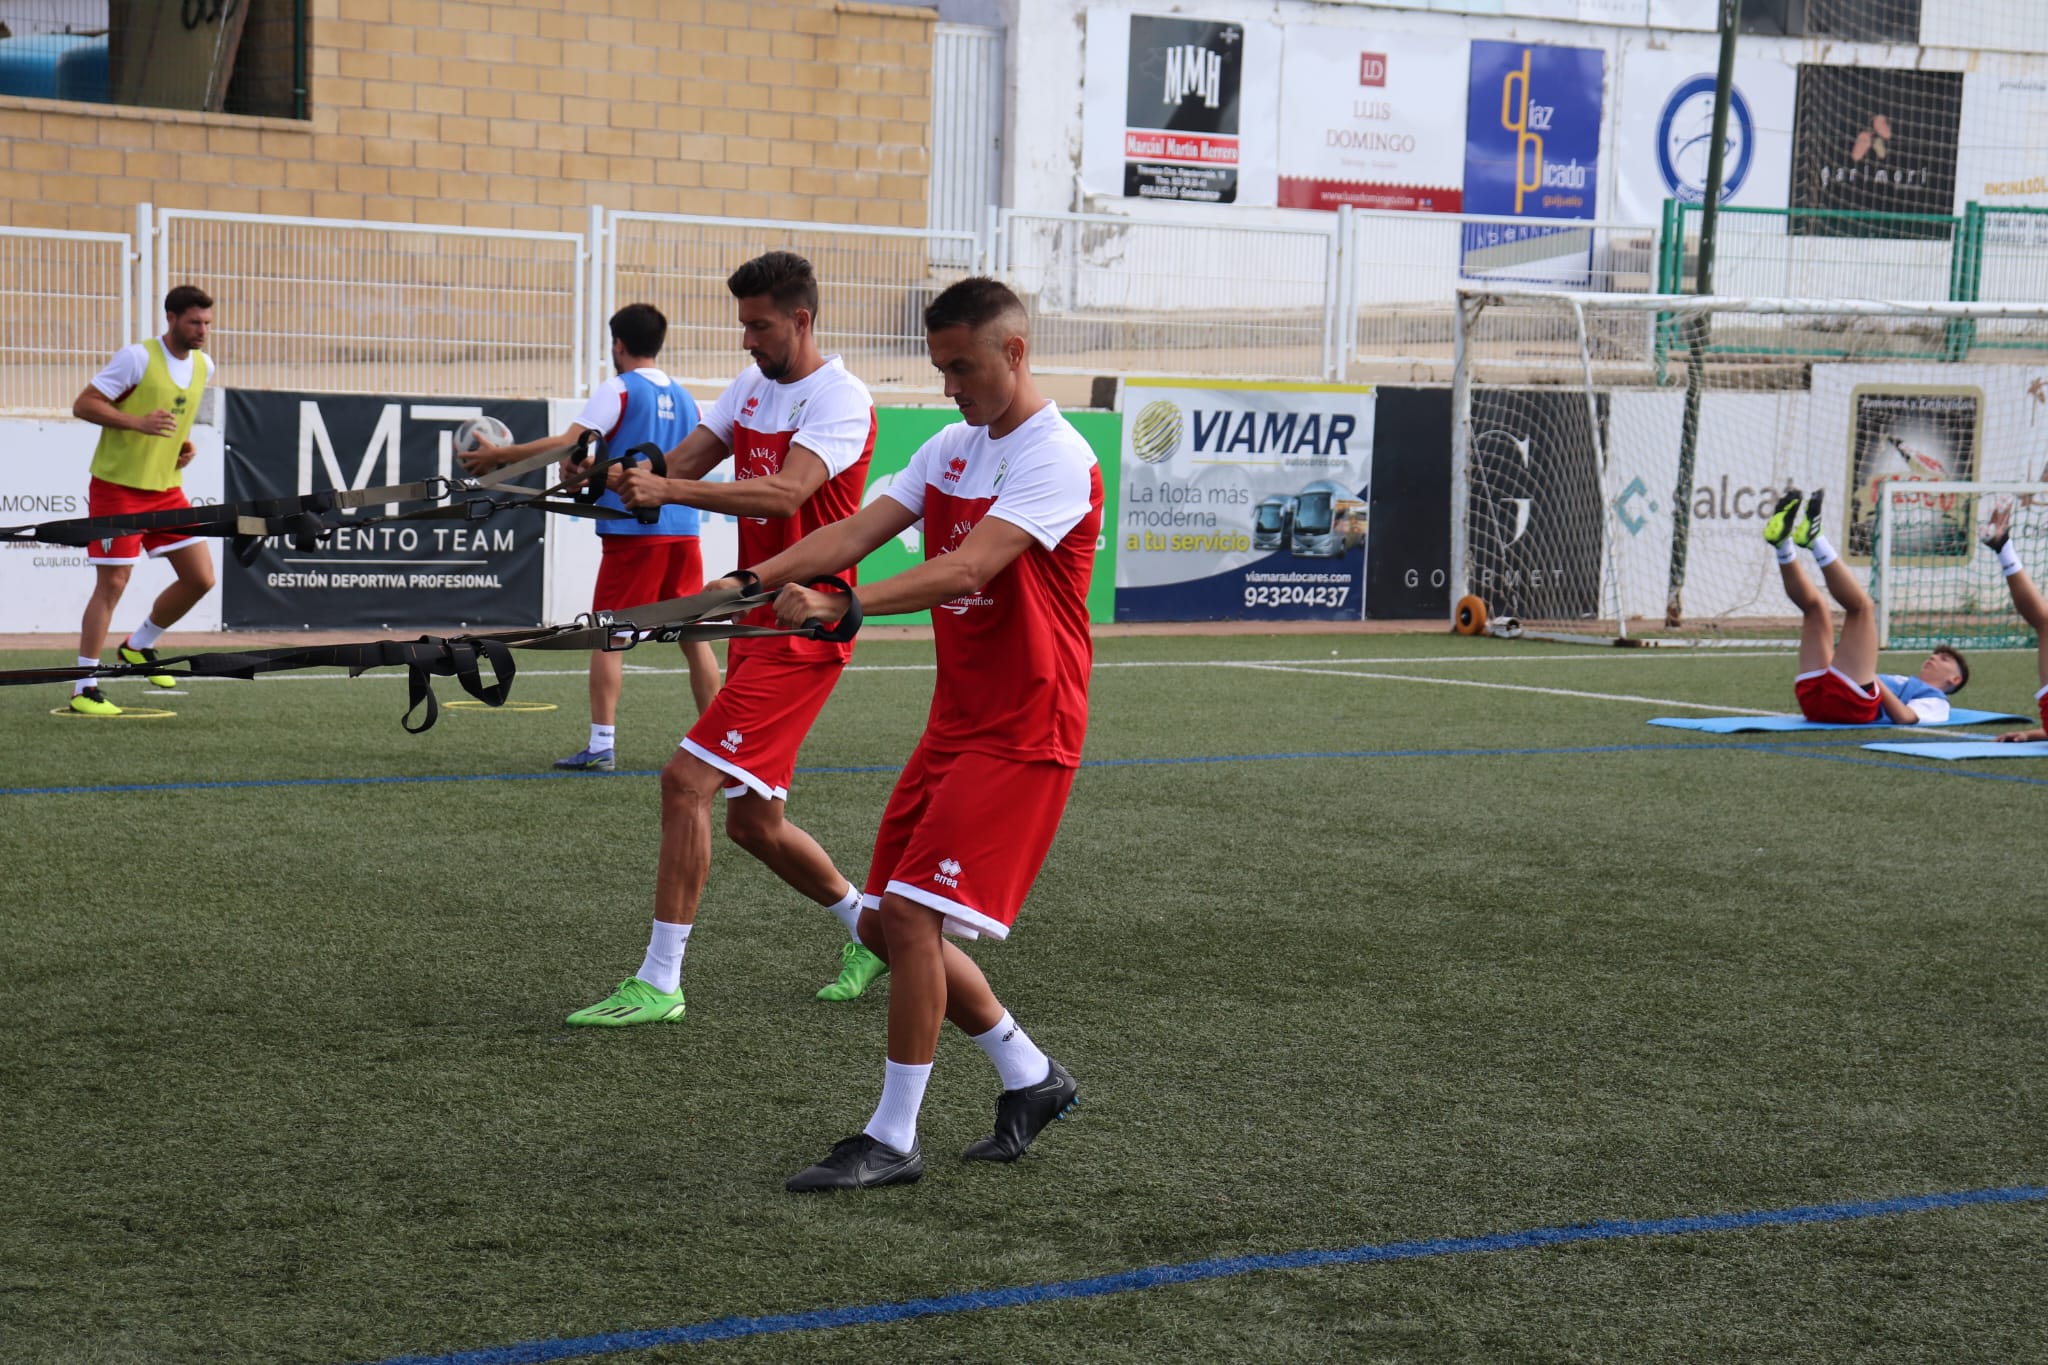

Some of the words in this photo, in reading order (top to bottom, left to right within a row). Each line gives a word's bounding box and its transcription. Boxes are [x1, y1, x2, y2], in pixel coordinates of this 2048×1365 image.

[1163, 45, 1222, 108] MMH
[1353, 101, 1392, 120] LUIS
[1127, 135, 1165, 154] Marcial
[1326, 129, 1416, 153] DOMINGO
[1193, 410, 1356, 455] VIAMAR
[297, 400, 483, 516] MT
[0, 495, 76, 512] MONES
[1129, 482, 1153, 503] La
[1159, 482, 1201, 504] flota
[1208, 484, 1249, 504] más
[1127, 507, 1217, 528] moderna
[433, 529, 515, 551] TEAM
[1126, 534, 1140, 551] a
[1145, 532, 1164, 551] tu
[1170, 531, 1250, 552] servicio
[267, 570, 328, 588] GESTIÓN
[331, 574, 407, 589] DEPORTIVA
[410, 574, 502, 589] PROFESIONAL
[1245, 571, 1351, 584] viamarautocares.com
[1404, 568, 1563, 589] GORMET
[1244, 586, 1350, 608] 923204237
[933, 872, 958, 889] errea
